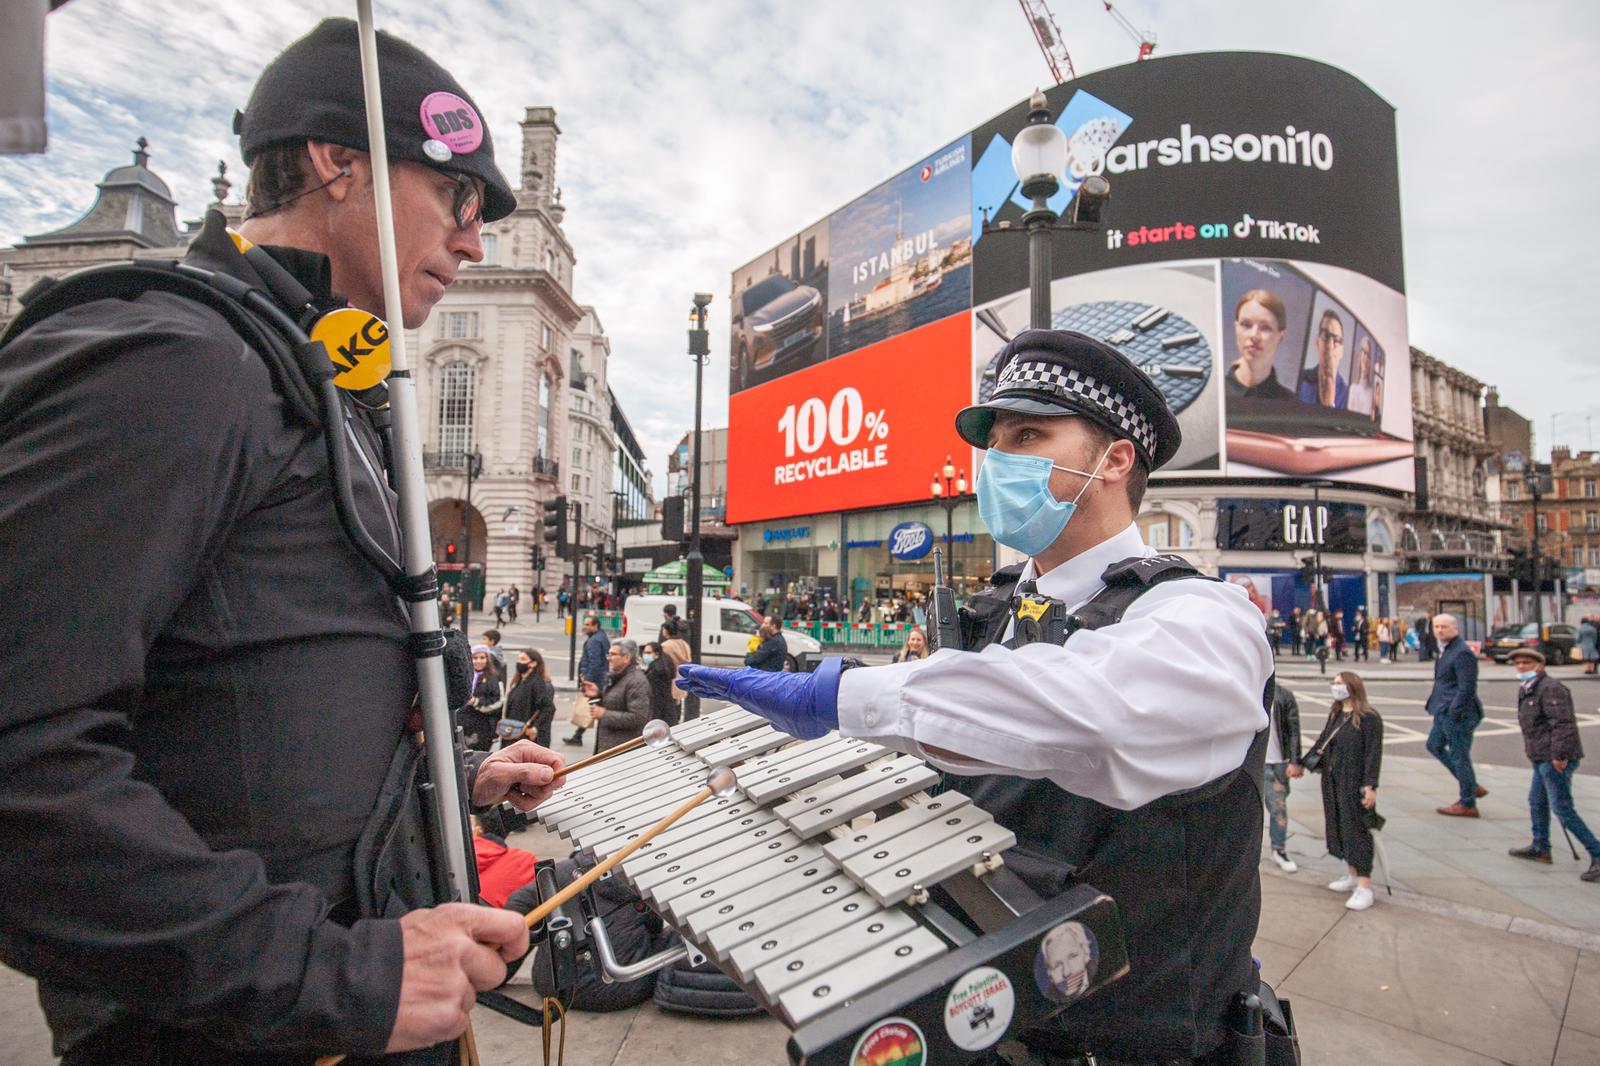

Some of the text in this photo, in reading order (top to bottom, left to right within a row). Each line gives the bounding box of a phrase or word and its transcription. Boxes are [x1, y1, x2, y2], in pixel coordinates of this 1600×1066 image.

[431, 108, 474, 135] BDS
[1106, 219, 1320, 249] it starts on TikTok
[853, 229, 938, 285] ISTANBUL
[778, 387, 889, 458] 100%
[774, 443, 889, 485] RECYCLABLE
[890, 527, 926, 554] Boots
[1283, 504, 1328, 545] GAP
[948, 979, 1008, 1018] BOYCOTT ISRAEL
